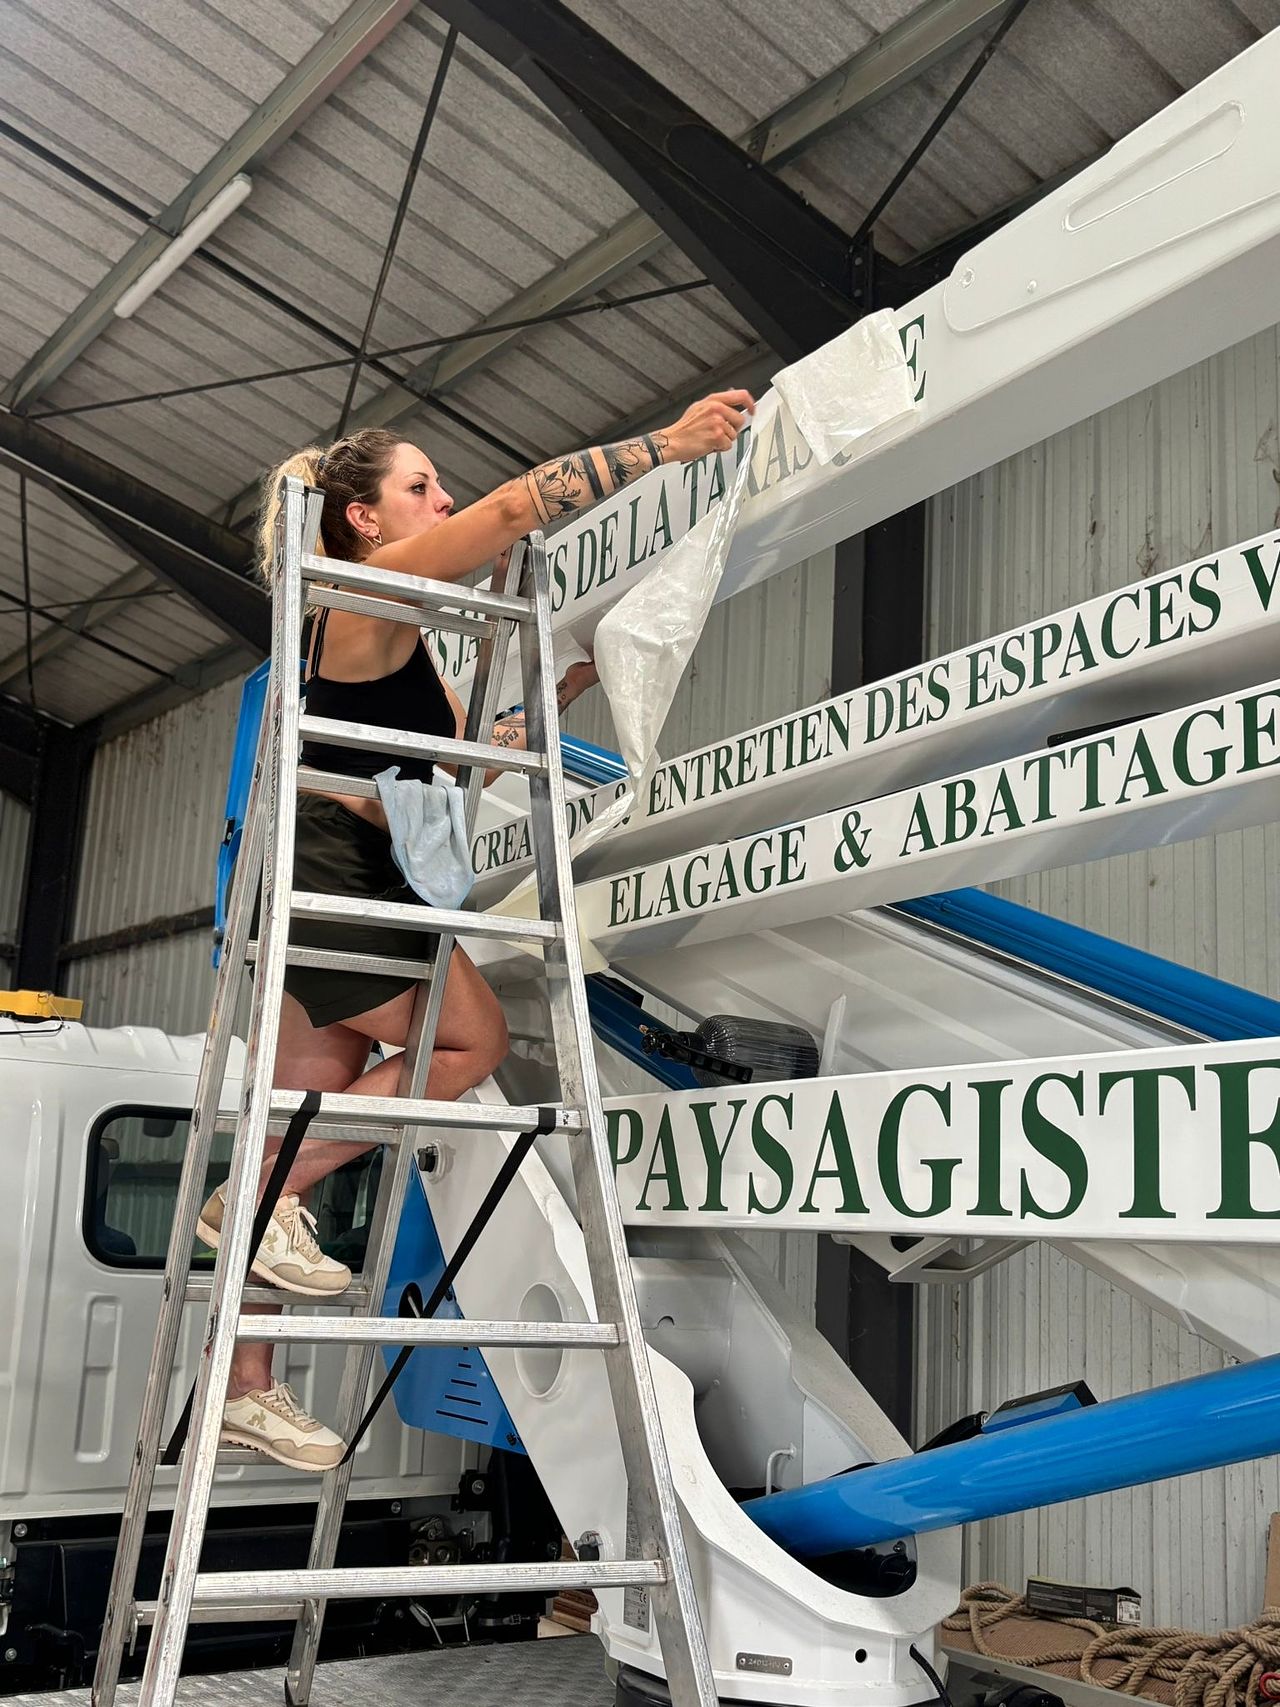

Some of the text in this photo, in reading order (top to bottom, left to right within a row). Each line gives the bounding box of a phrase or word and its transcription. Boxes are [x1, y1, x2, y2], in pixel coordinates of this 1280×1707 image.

[574, 510, 619, 601] DE
[626, 479, 674, 571] LA
[647, 698, 854, 817] ENTRETIEN
[863, 661, 950, 744] DES
[965, 559, 1222, 711] ESPACES
[607, 688, 1280, 928] ELAGAGE & ABATTAGE
[603, 1058, 1280, 1220] PAYSAGISTE
